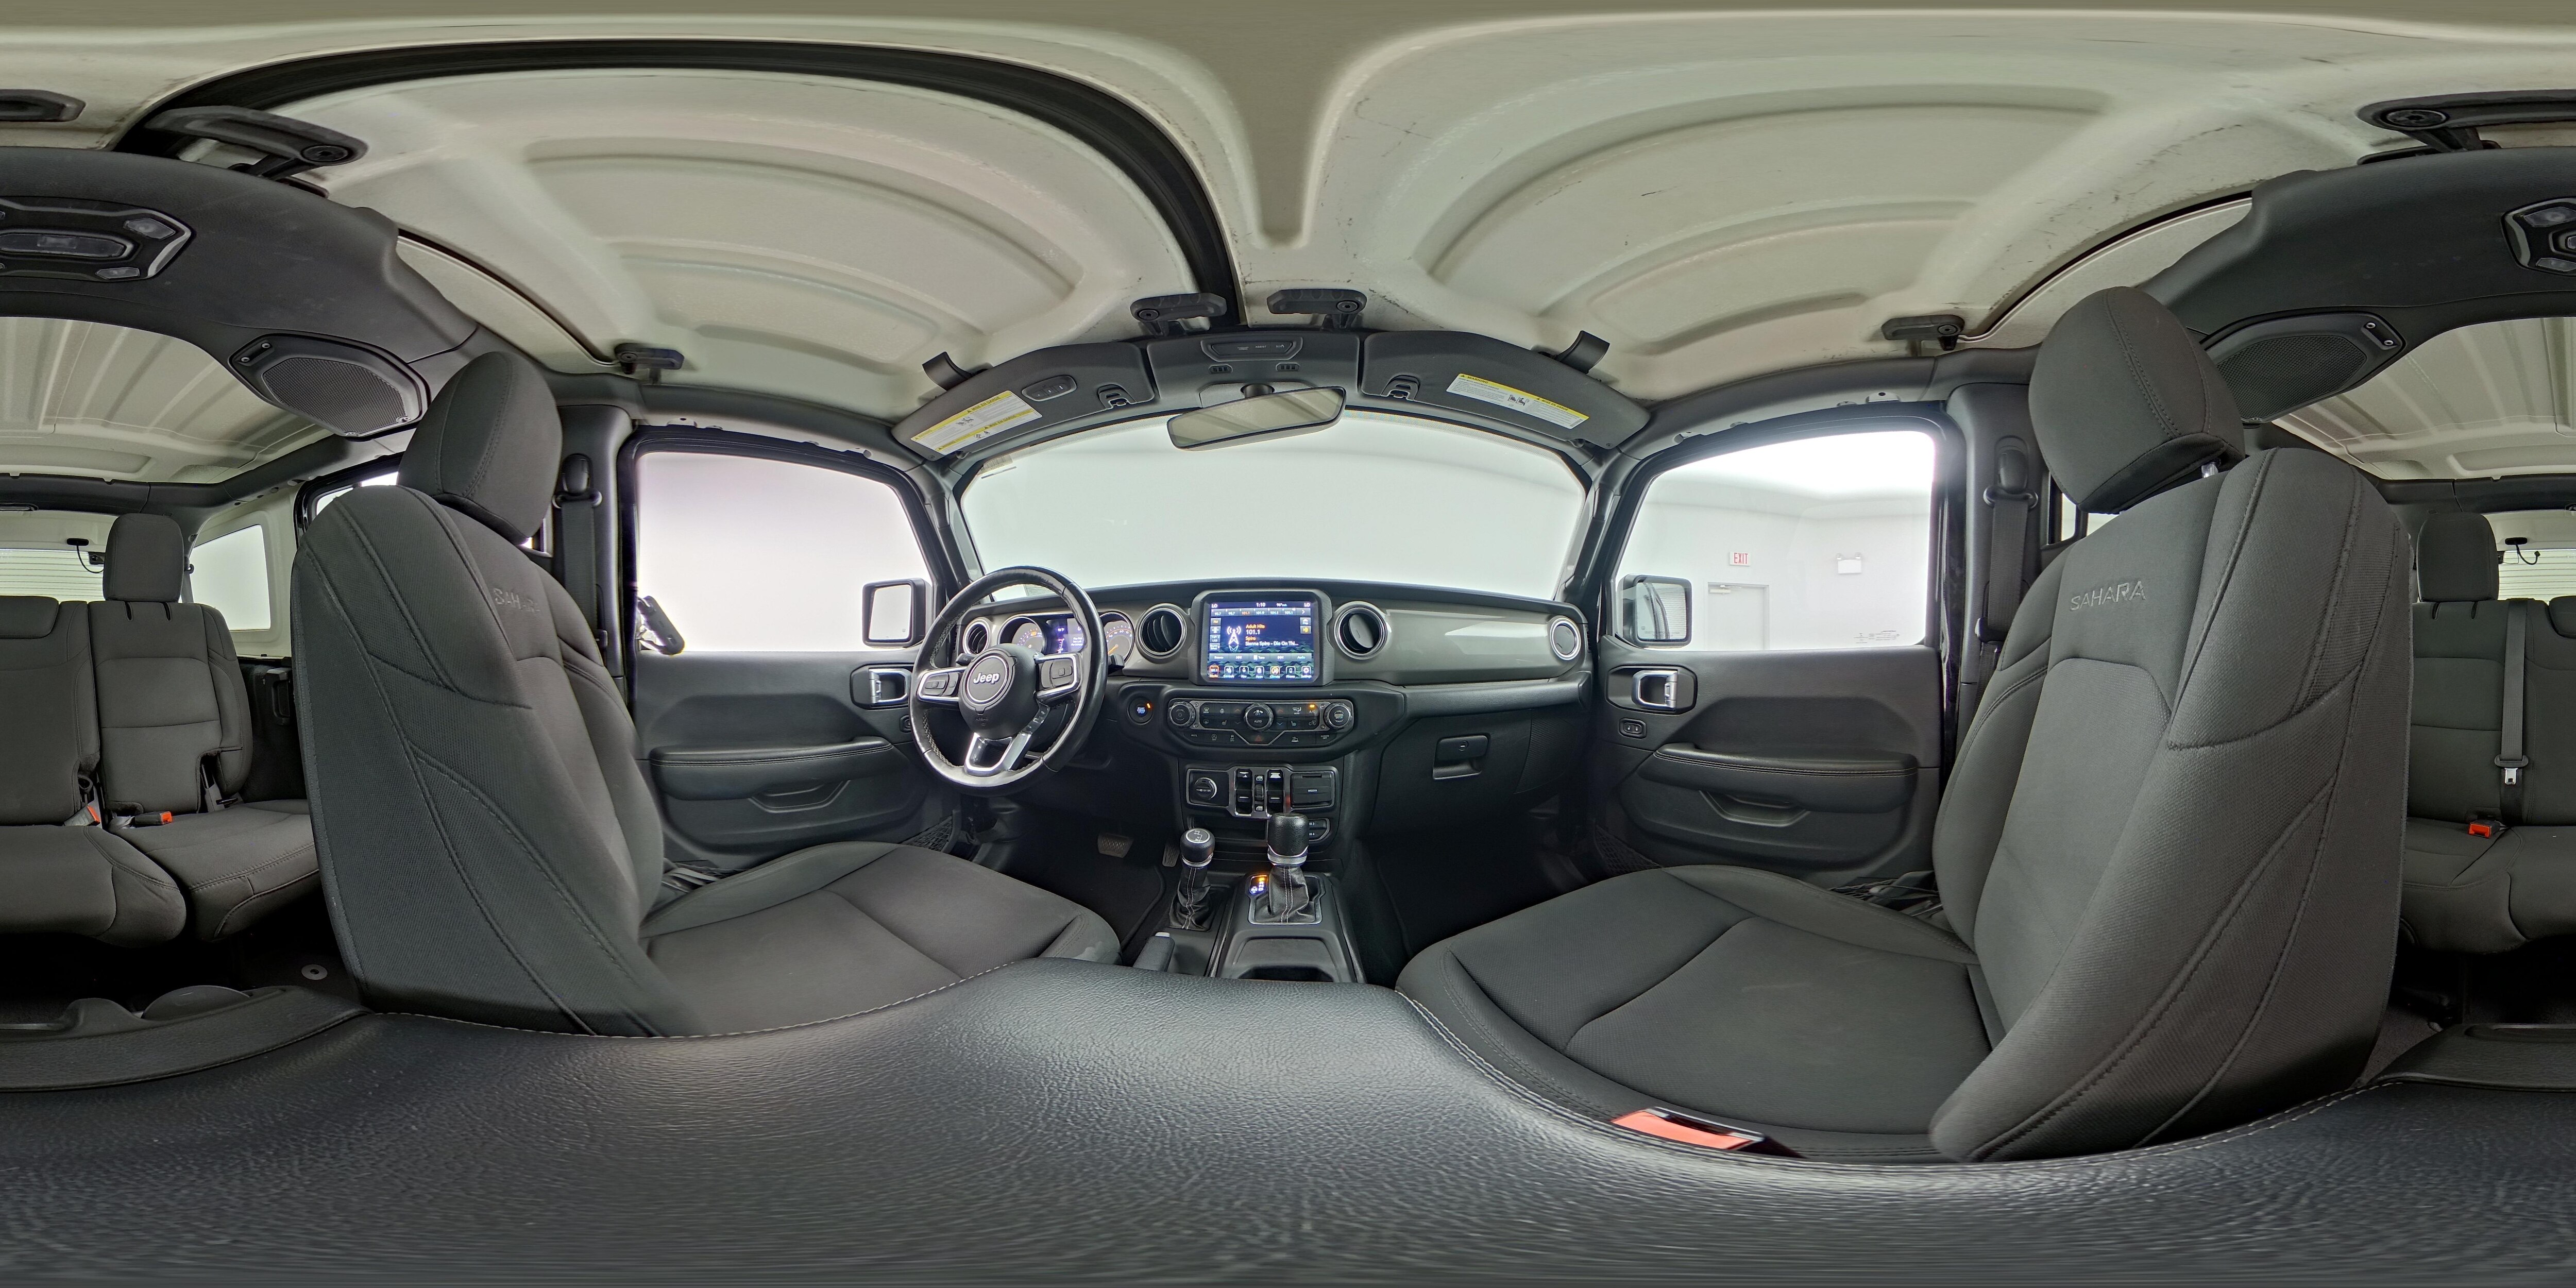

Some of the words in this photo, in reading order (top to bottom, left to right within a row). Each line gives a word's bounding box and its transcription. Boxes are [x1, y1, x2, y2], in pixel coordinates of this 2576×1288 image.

[1734, 552, 1748, 564] EXIT
[2070, 581, 2147, 611] SAHARA
[973, 672, 1000, 684] Jeep
